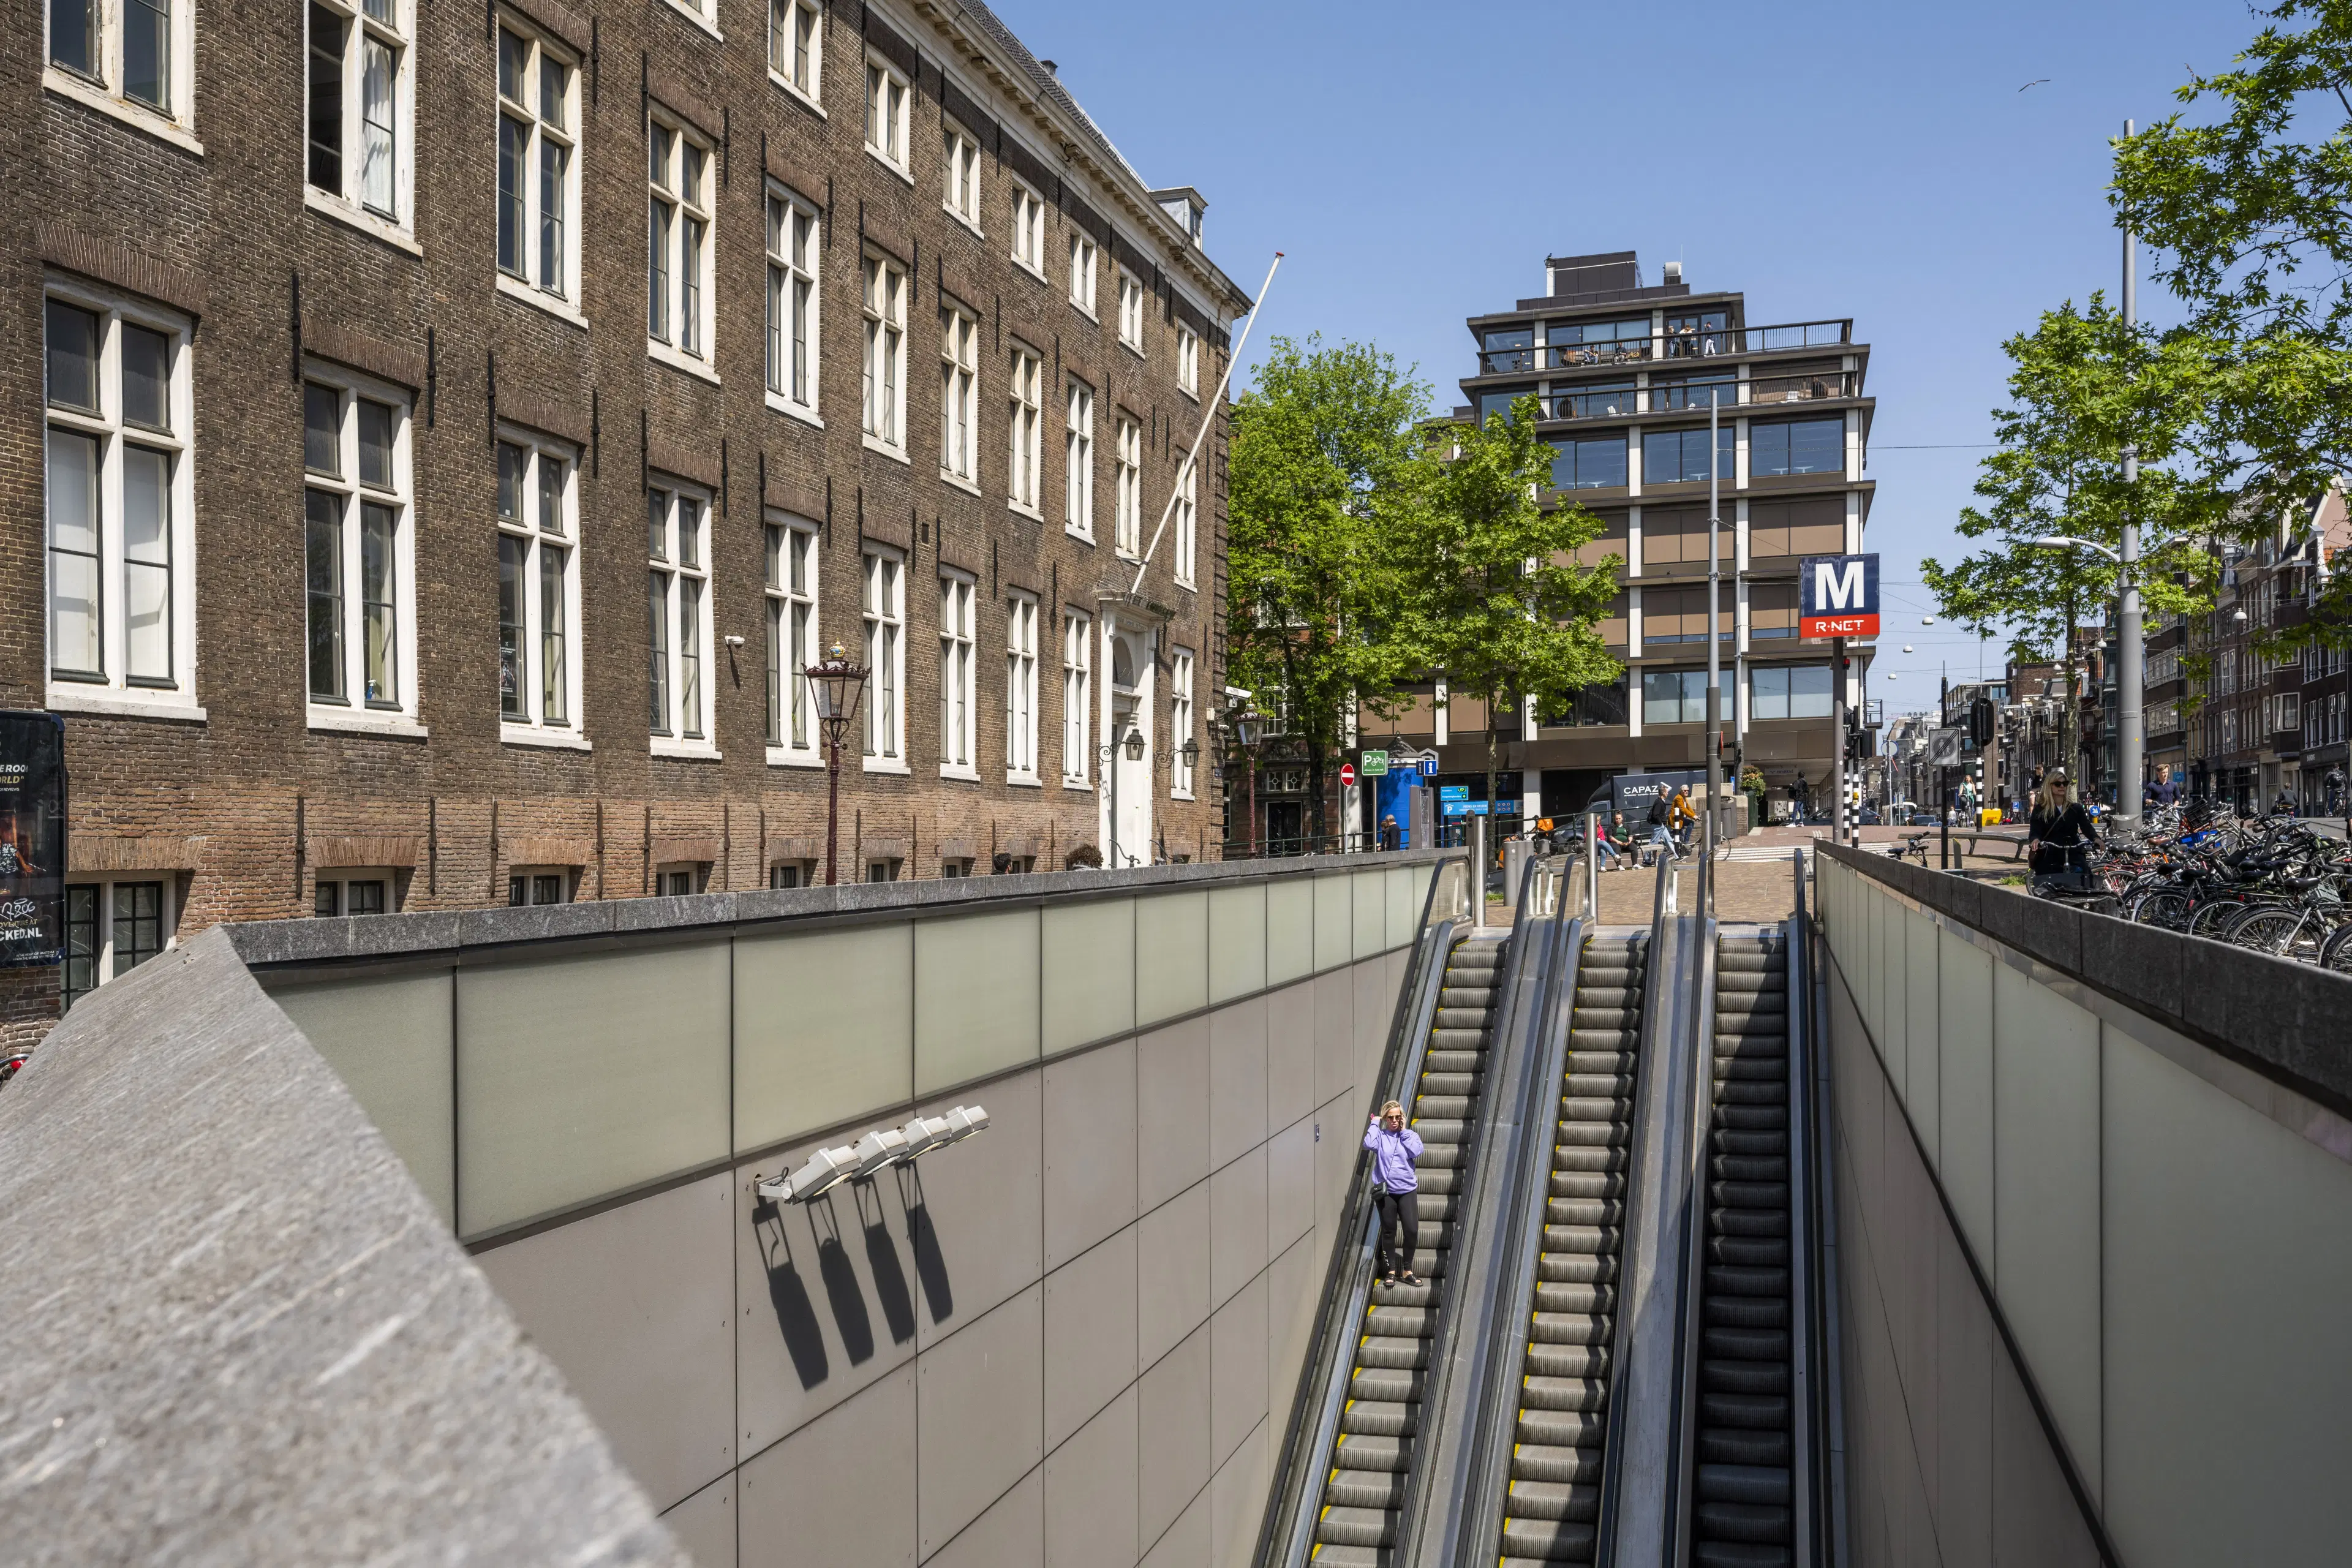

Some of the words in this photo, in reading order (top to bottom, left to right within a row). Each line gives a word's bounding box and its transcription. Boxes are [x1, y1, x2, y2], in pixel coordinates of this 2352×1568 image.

[1815, 561, 1864, 610] M
[1364, 755, 1372, 766] P
[1624, 785, 1658, 794] CAPAZ
